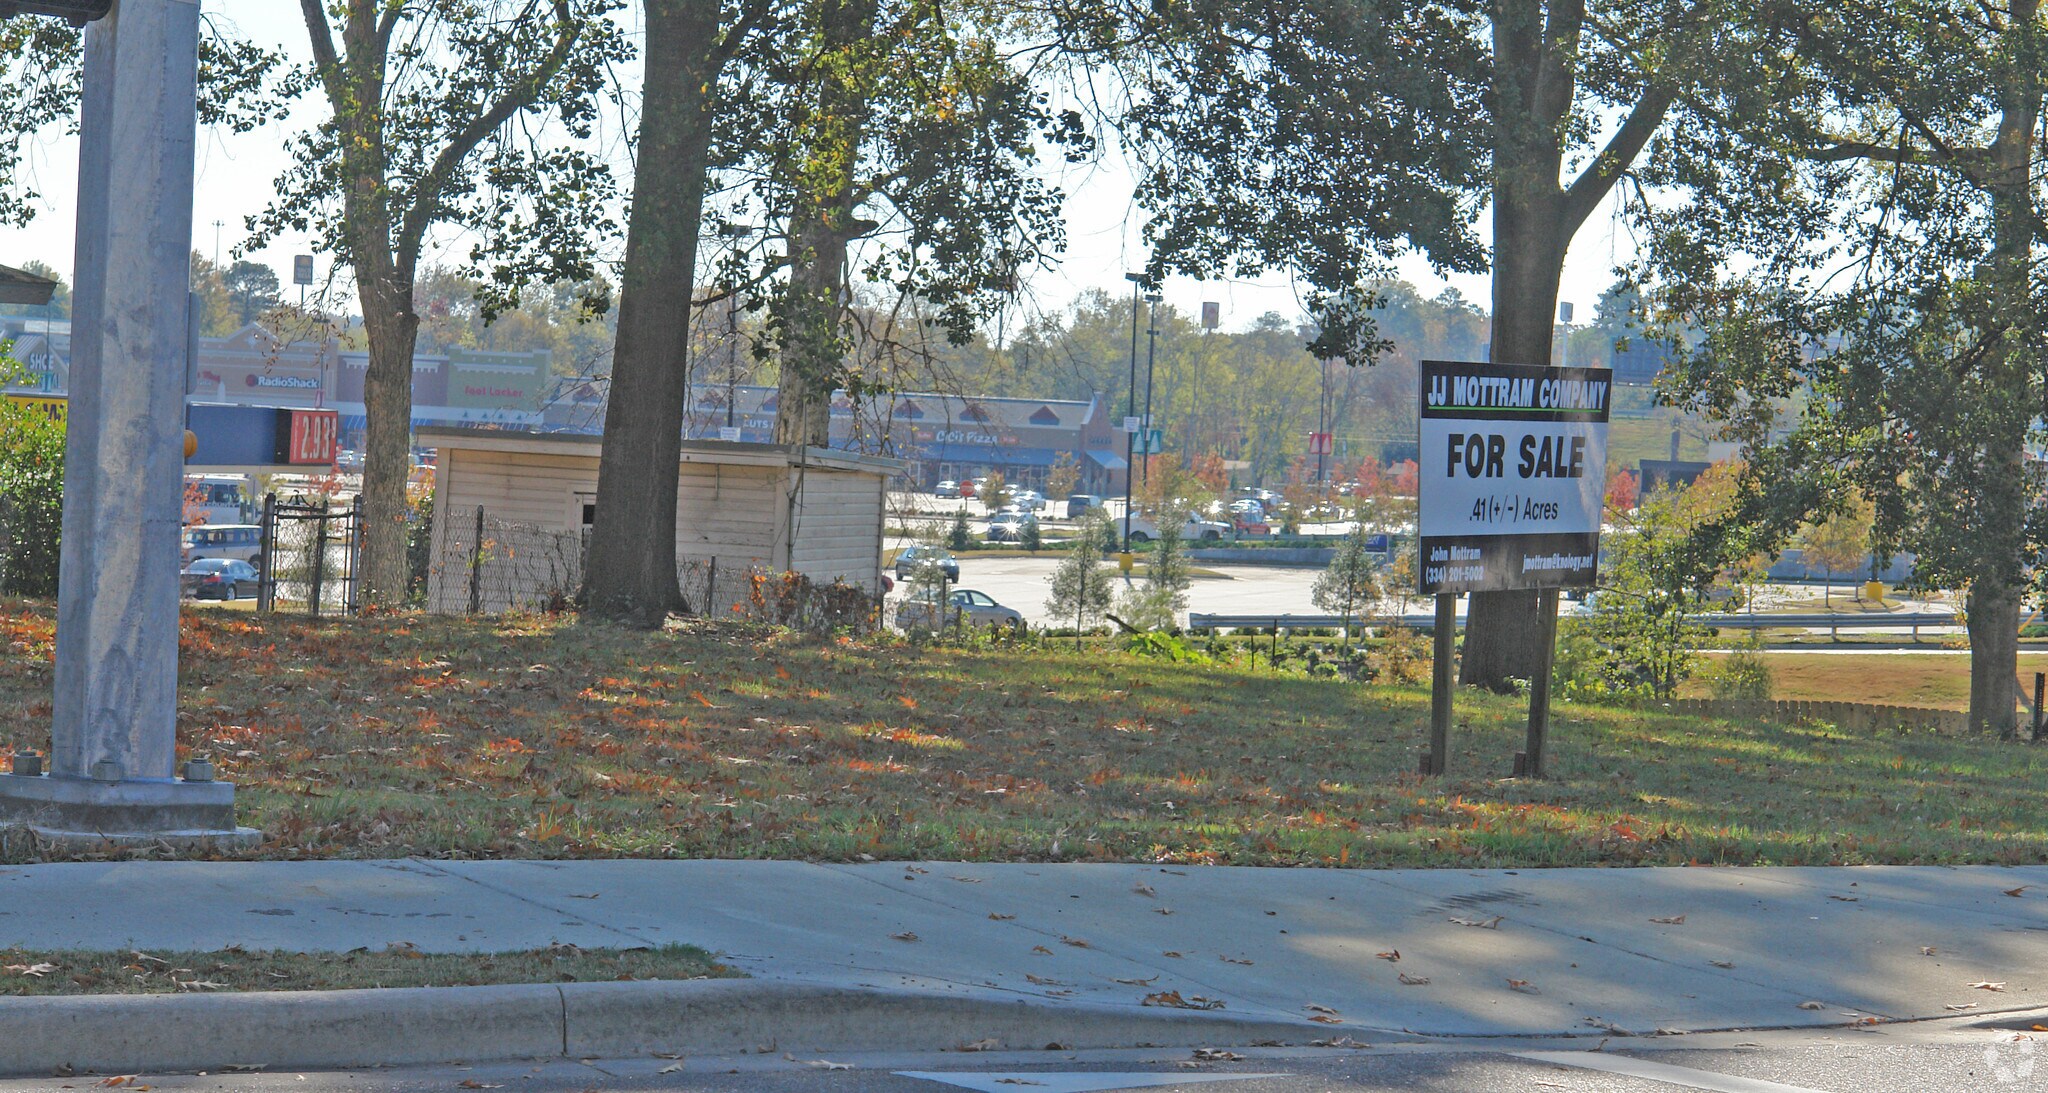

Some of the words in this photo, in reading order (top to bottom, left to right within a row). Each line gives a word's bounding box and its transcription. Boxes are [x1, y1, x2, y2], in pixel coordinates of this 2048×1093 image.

[258, 376, 318, 388] RadioShack
[1428, 375, 1447, 406] JJ
[1453, 376, 1535, 407] MOTTRAM
[1539, 379, 1607, 409] COMPANY
[966, 431, 998, 444] Pizza
[1447, 433, 1506, 479] FOR
[1518, 434, 1586, 479] SALE
[1523, 497, 1558, 520] Acres
[1430, 546, 1448, 562] John
[1450, 546, 1481, 561] Mottram
[1522, 553, 1593, 574] jmottram@knology.net
[1425, 566, 1446, 584] (334)
